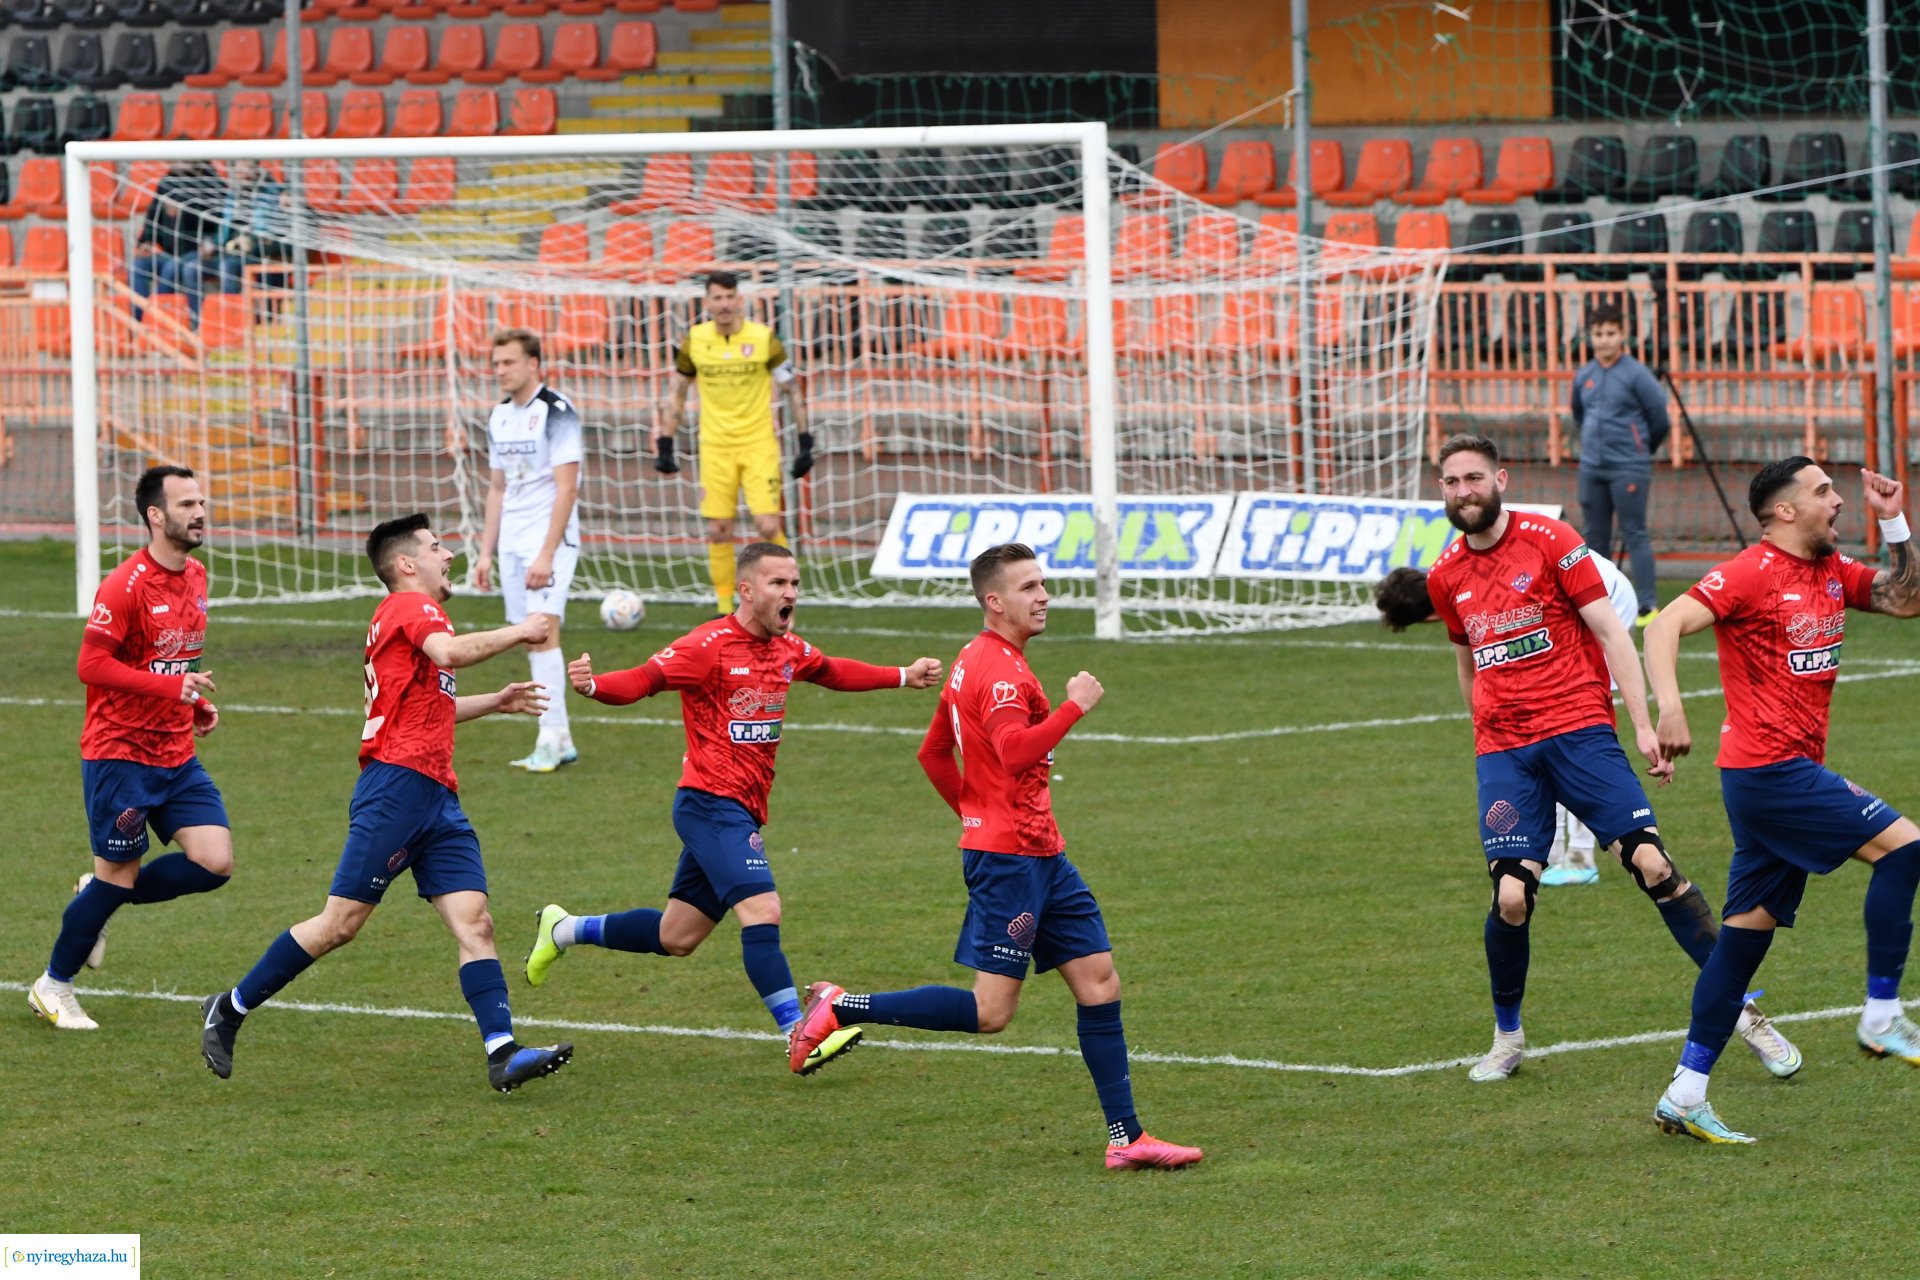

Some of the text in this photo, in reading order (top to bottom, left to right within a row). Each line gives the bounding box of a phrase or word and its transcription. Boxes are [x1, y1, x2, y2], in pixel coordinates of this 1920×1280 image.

[905, 509, 1205, 563] TiPPMIX
[1249, 506, 1463, 570] TiPPM
[153, 605, 169, 614] JAKO
[1793, 648, 1840, 670] TiPPM
[153, 660, 200, 676] TiPPM
[729, 667, 750, 675] JAKO
[733, 722, 781, 739] TiPPM
[1632, 808, 1651, 819] JAKO
[1483, 835, 1529, 846] PRESTIGE
